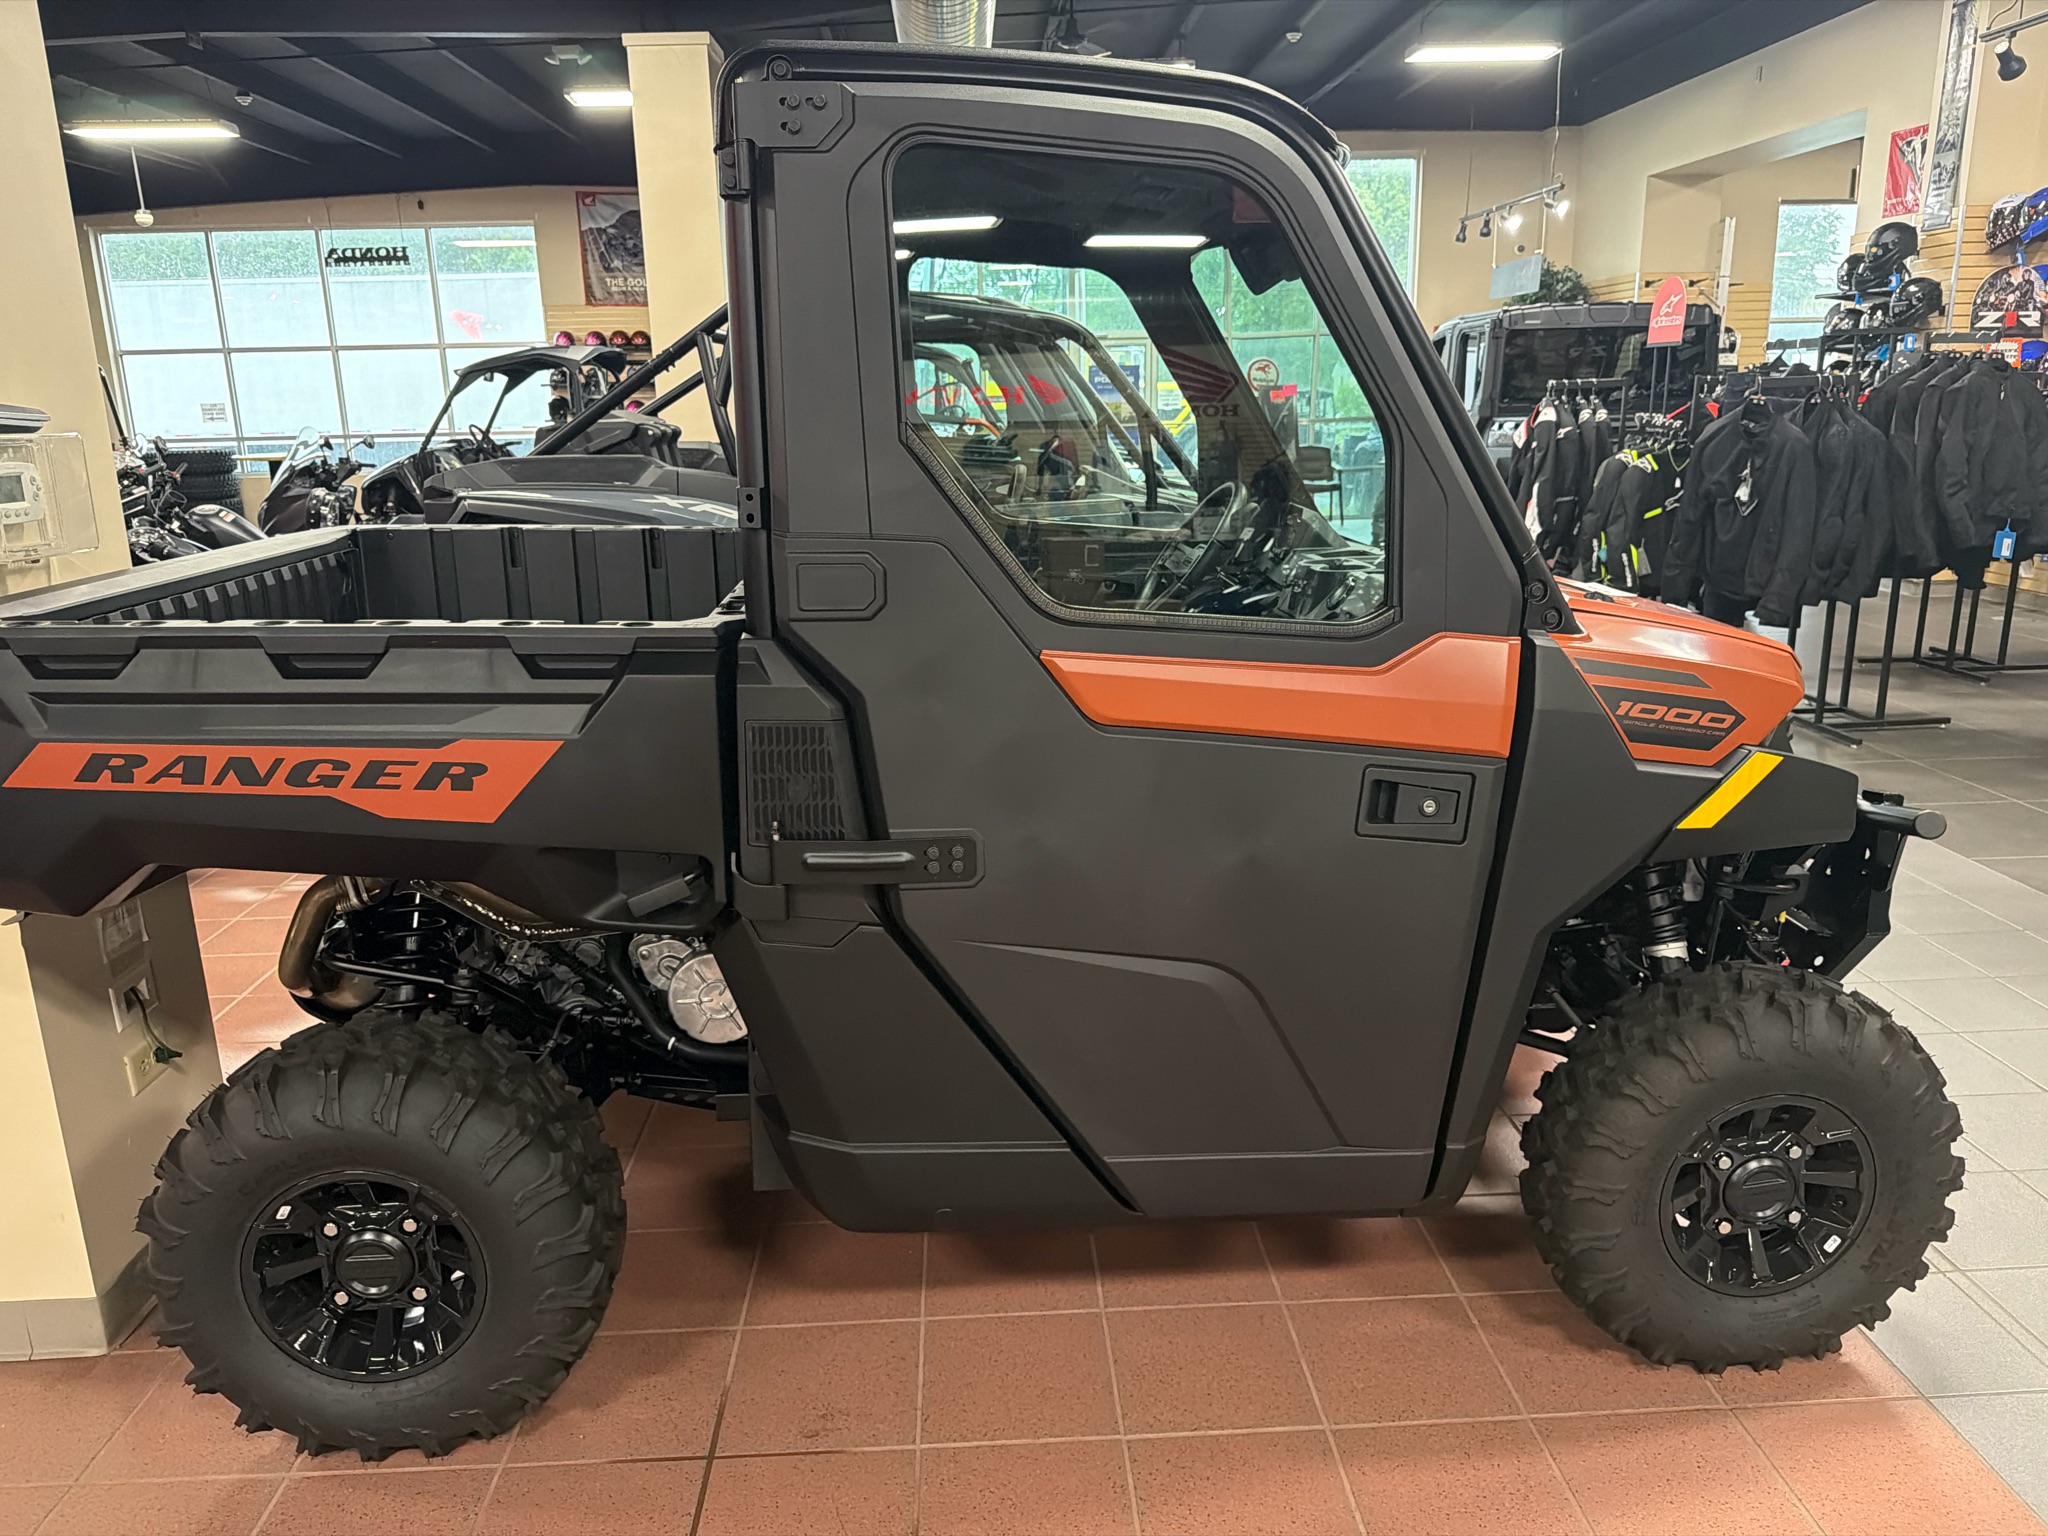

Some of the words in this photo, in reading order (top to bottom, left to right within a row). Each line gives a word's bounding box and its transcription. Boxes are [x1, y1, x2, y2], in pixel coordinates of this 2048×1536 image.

[605, 277, 625, 287] THE
[626, 278, 648, 287] GOL
[1615, 700, 1736, 729] 1000
[1622, 719, 1656, 728] SINGLE
[1658, 723, 1705, 734] OVERHEAD
[73, 752, 489, 792] RANGER
